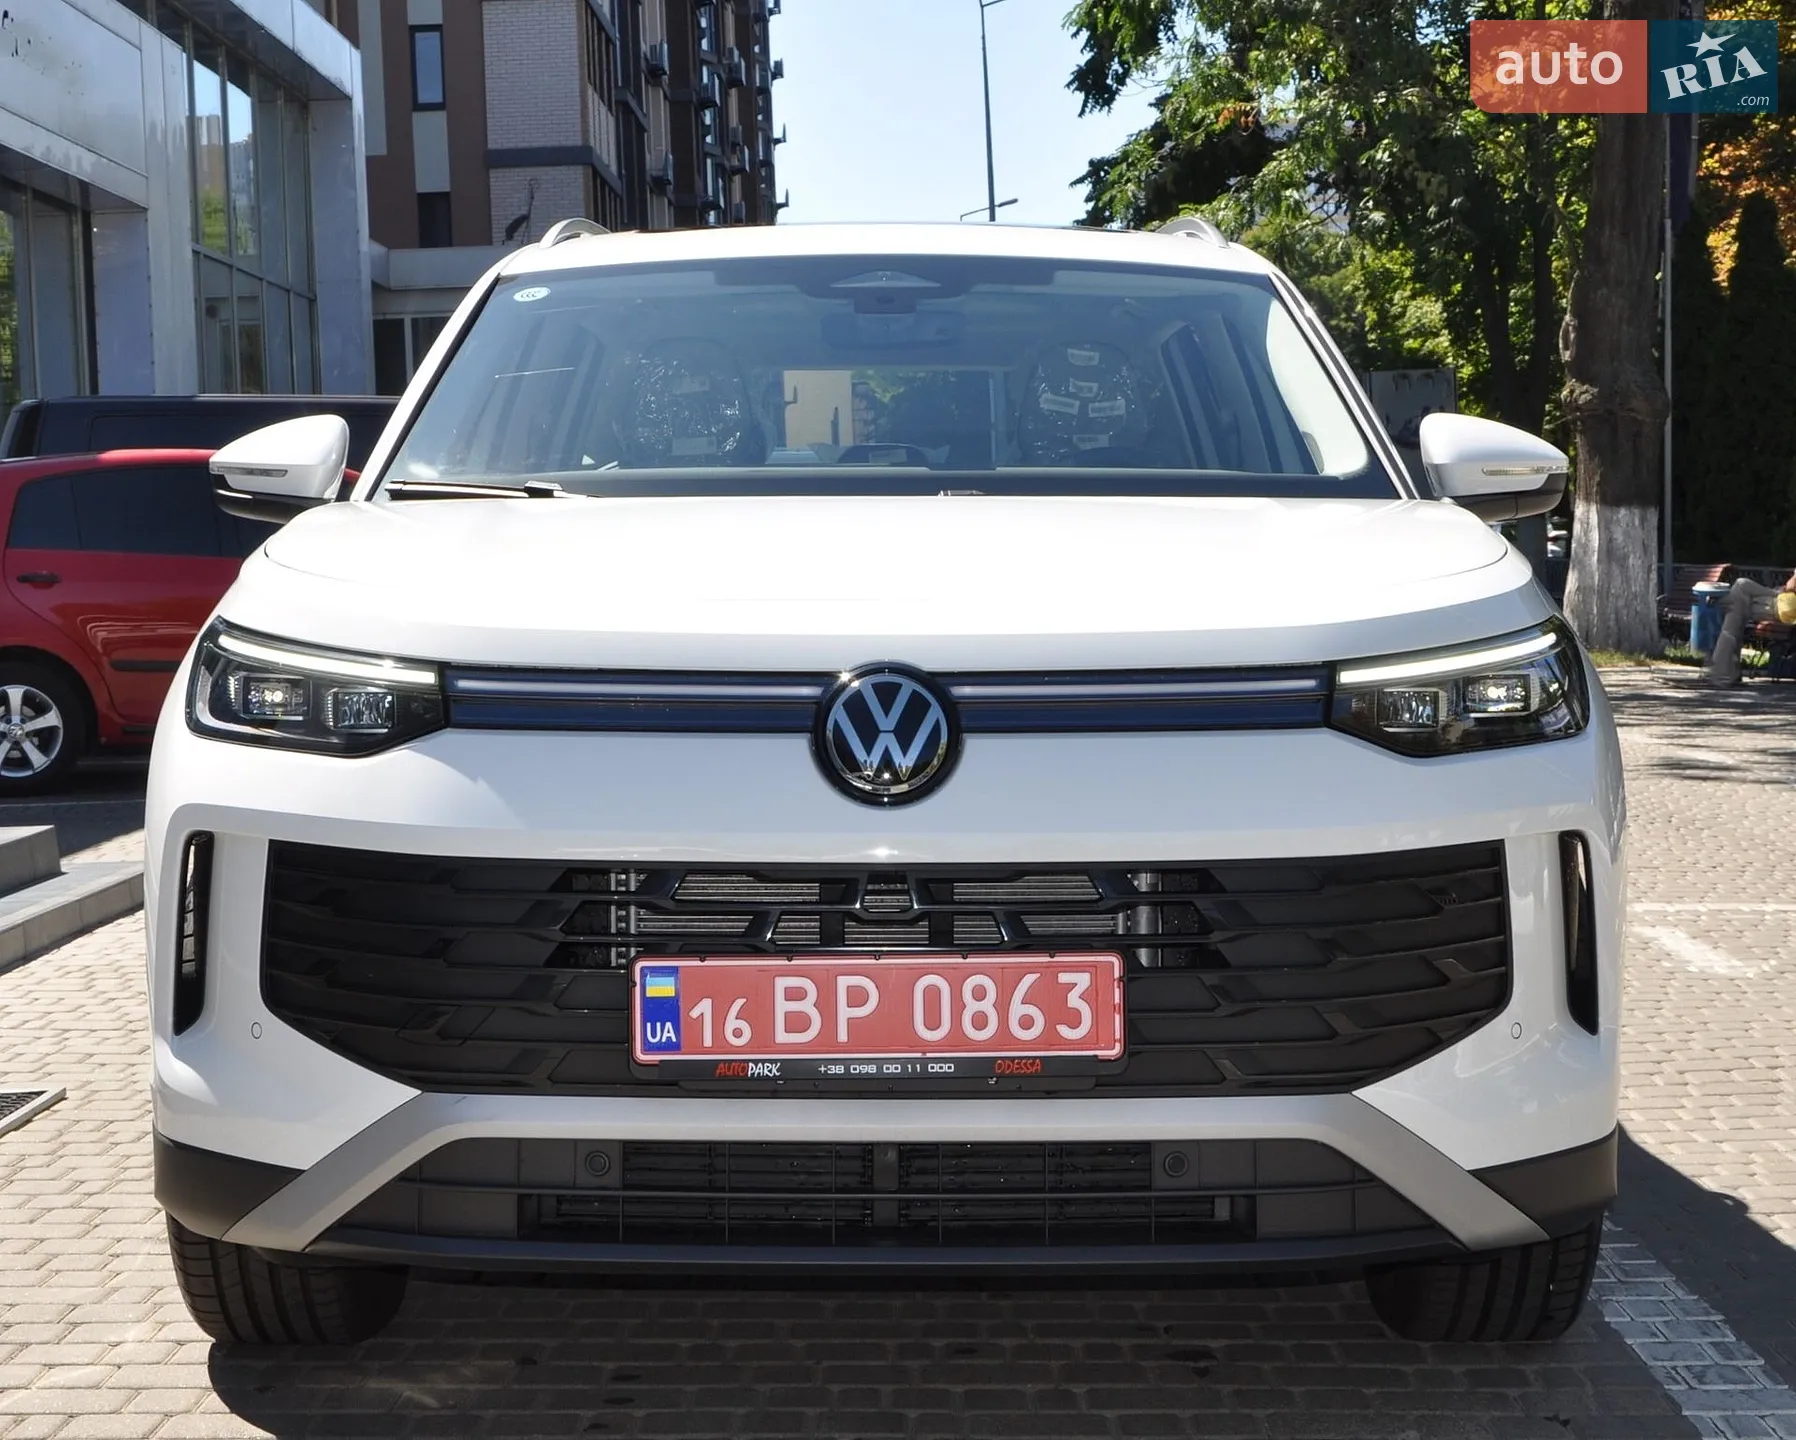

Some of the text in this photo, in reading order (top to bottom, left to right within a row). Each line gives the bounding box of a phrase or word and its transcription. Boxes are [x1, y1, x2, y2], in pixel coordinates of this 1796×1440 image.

[688, 972, 1093, 1047] 16 BP 0863
[646, 1021, 677, 1043] UA
[715, 1062, 781, 1077] AUTOPARK
[818, 1063, 954, 1074] +38 098 00 11 000
[995, 1058, 1042, 1074] ODESSA
